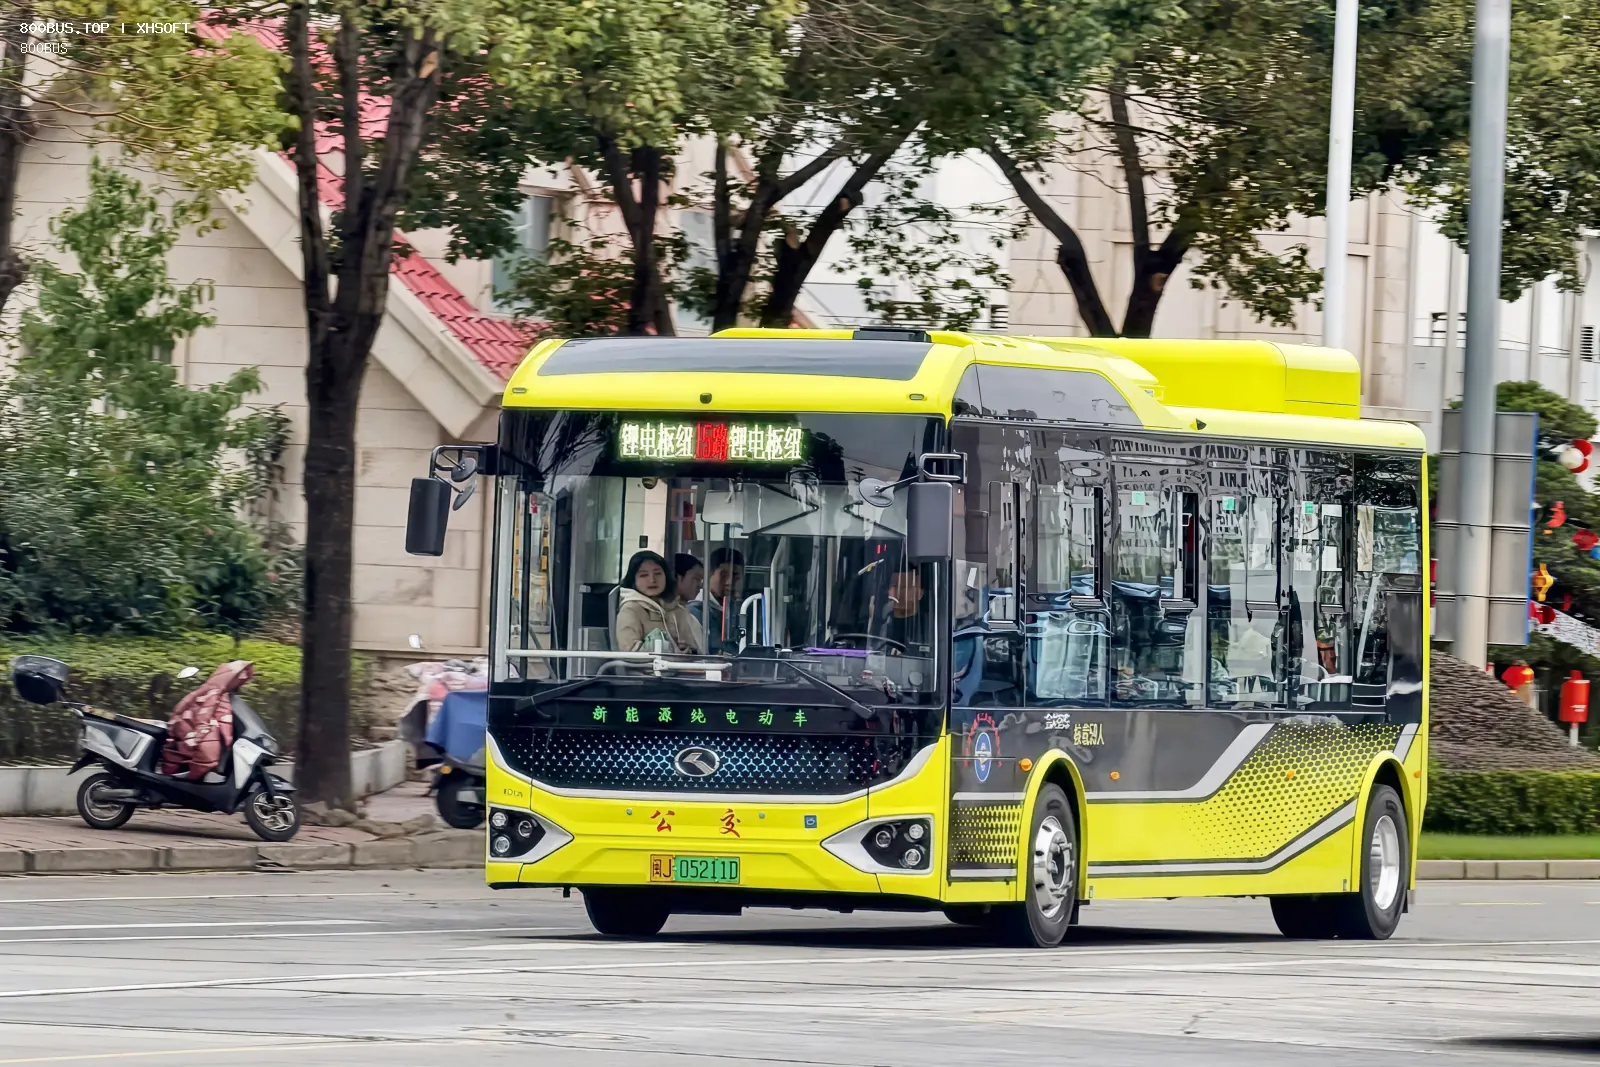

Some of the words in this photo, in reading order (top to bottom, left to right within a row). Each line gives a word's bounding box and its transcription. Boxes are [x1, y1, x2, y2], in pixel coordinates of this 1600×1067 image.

[592, 705, 808, 728] 新能源纯电动车
[650, 808, 741, 839] 公交
